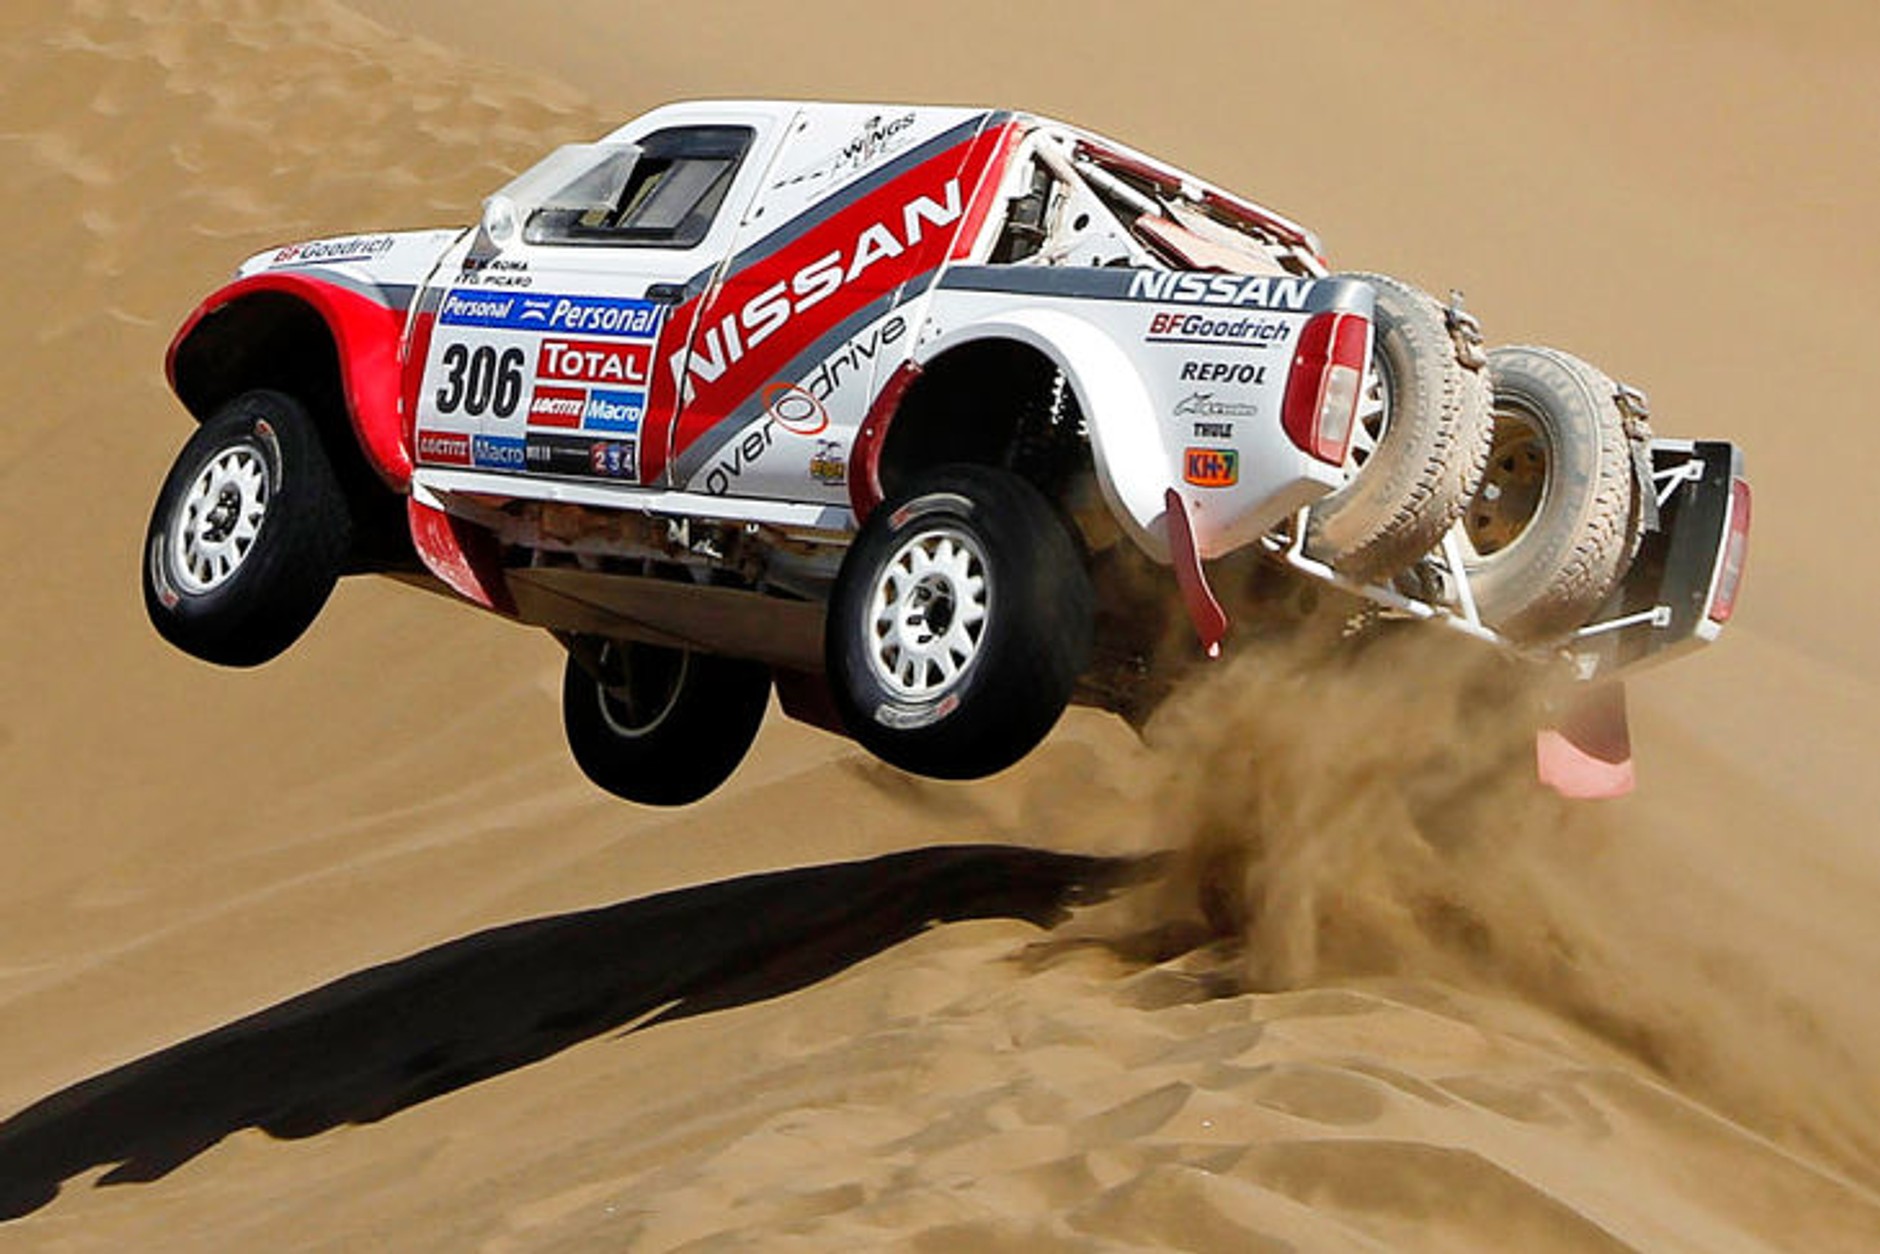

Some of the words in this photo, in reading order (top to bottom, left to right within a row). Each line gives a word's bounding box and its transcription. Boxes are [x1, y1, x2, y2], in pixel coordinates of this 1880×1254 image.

[273, 236, 395, 263] BFGoodrich
[669, 178, 963, 408] NISSAN
[1128, 270, 1316, 310] NISSAN
[443, 296, 515, 319] Personal
[548, 299, 661, 333] Personal
[1150, 312, 1291, 341] BFGoodrich
[436, 343, 525, 419] 306
[1180, 361, 1267, 385] REPSOL
[588, 399, 642, 422] Macro
[473, 440, 525, 463] Macro
